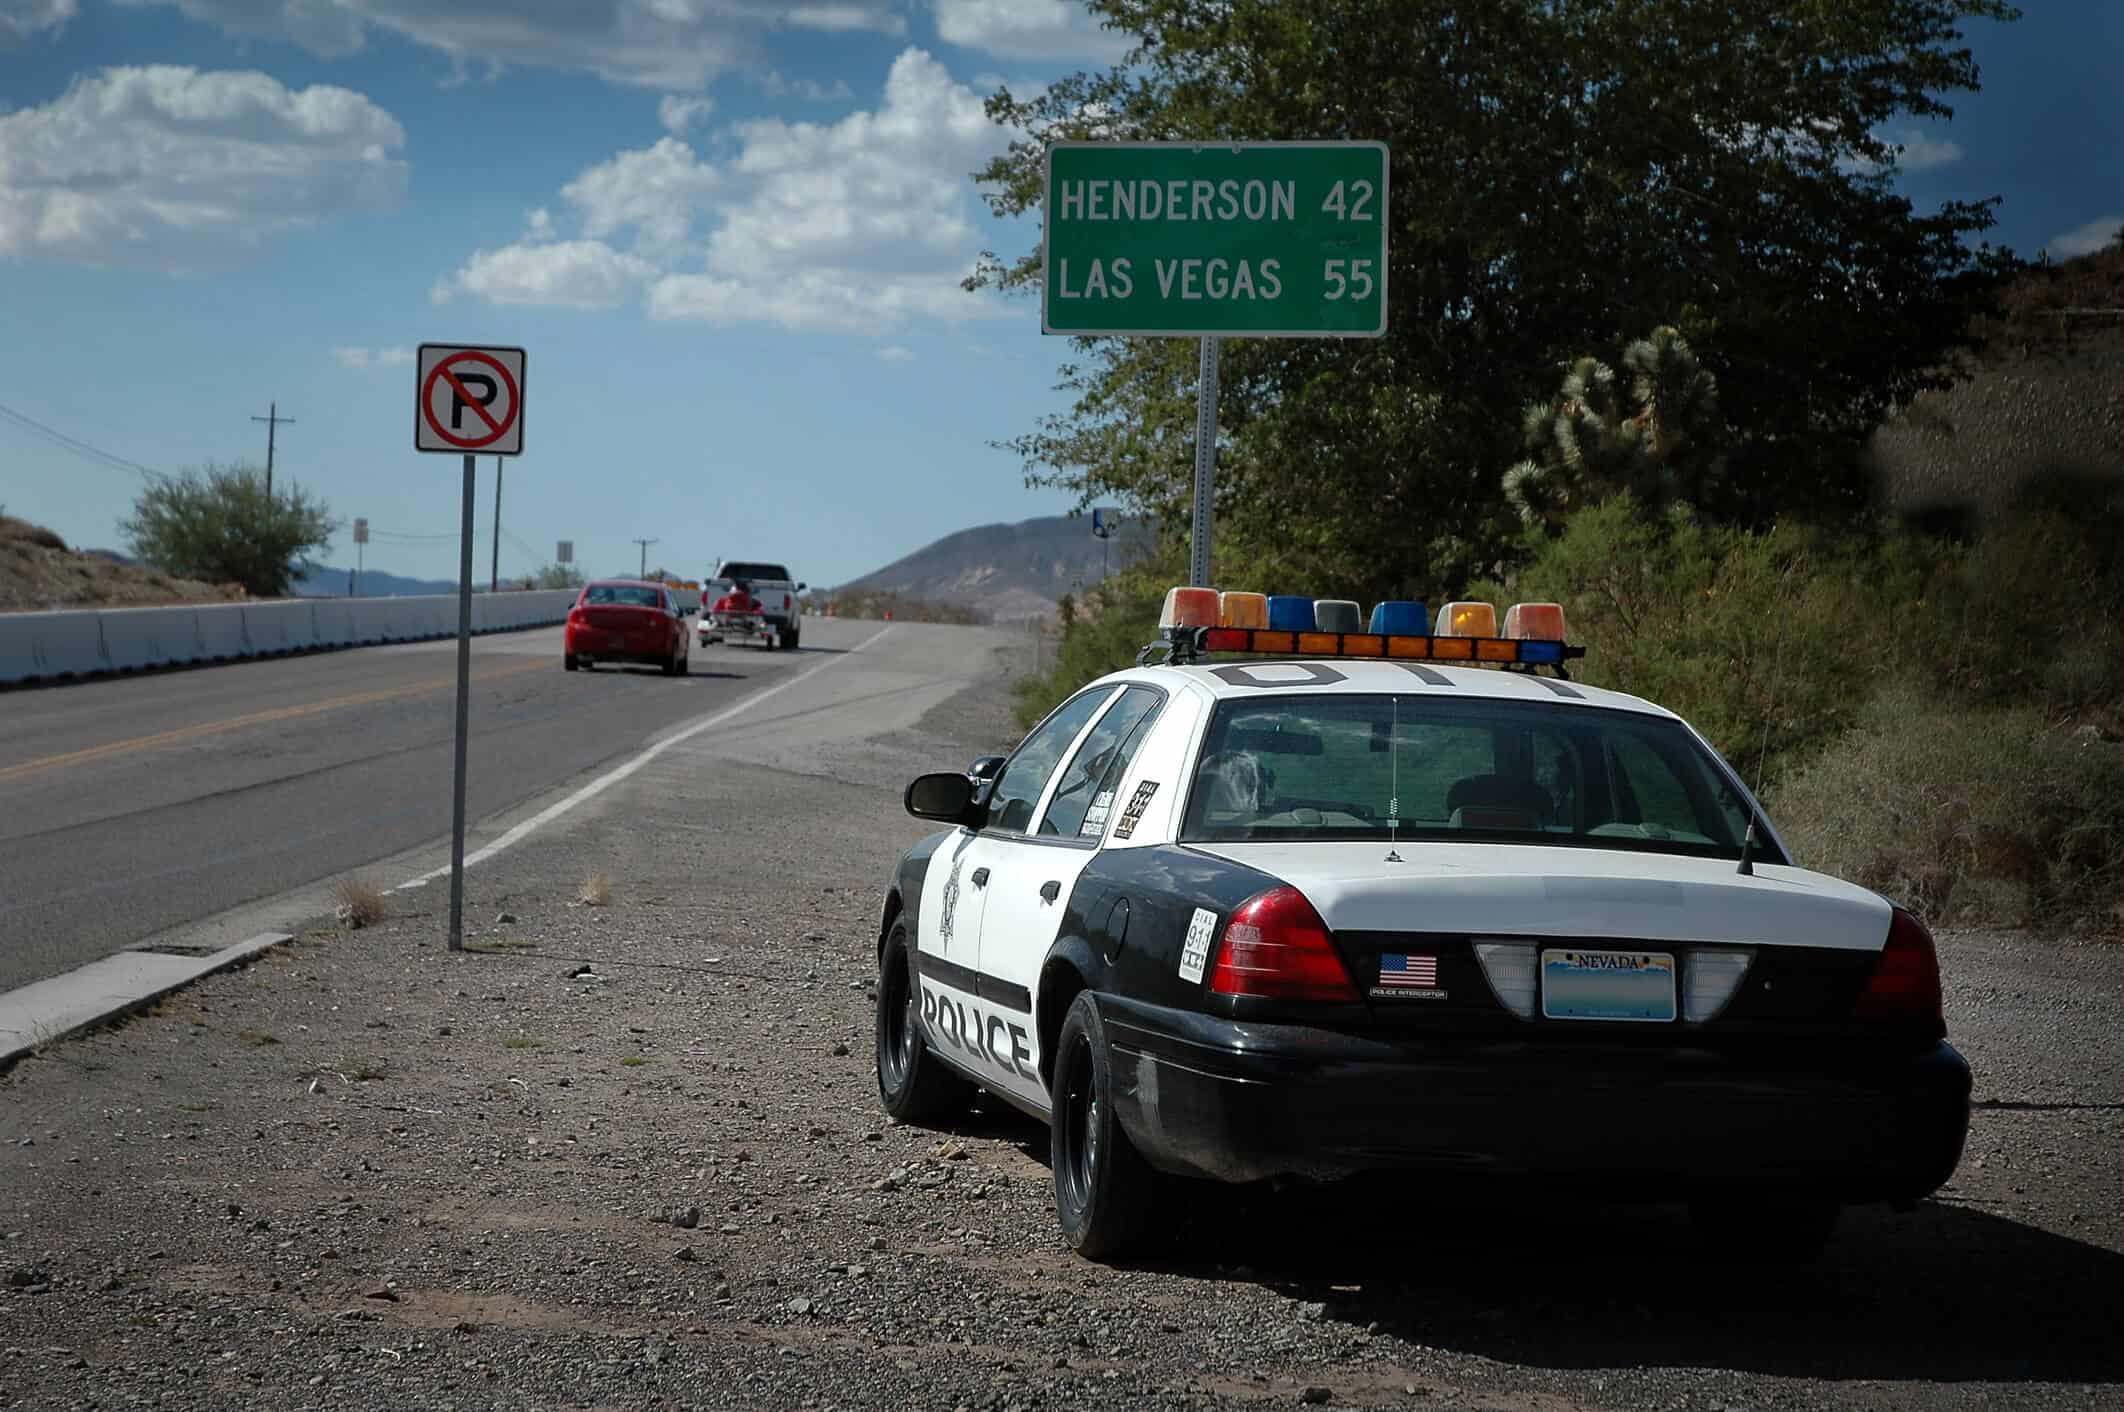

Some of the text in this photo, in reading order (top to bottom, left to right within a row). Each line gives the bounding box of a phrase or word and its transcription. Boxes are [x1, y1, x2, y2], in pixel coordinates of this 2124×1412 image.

[1060, 179, 1375, 221] HENDERSON 42
[1059, 258, 1374, 300] LAS VEGAS 55
[1578, 955, 1640, 969] NEVADA
[921, 985, 1039, 1083] POLICE
